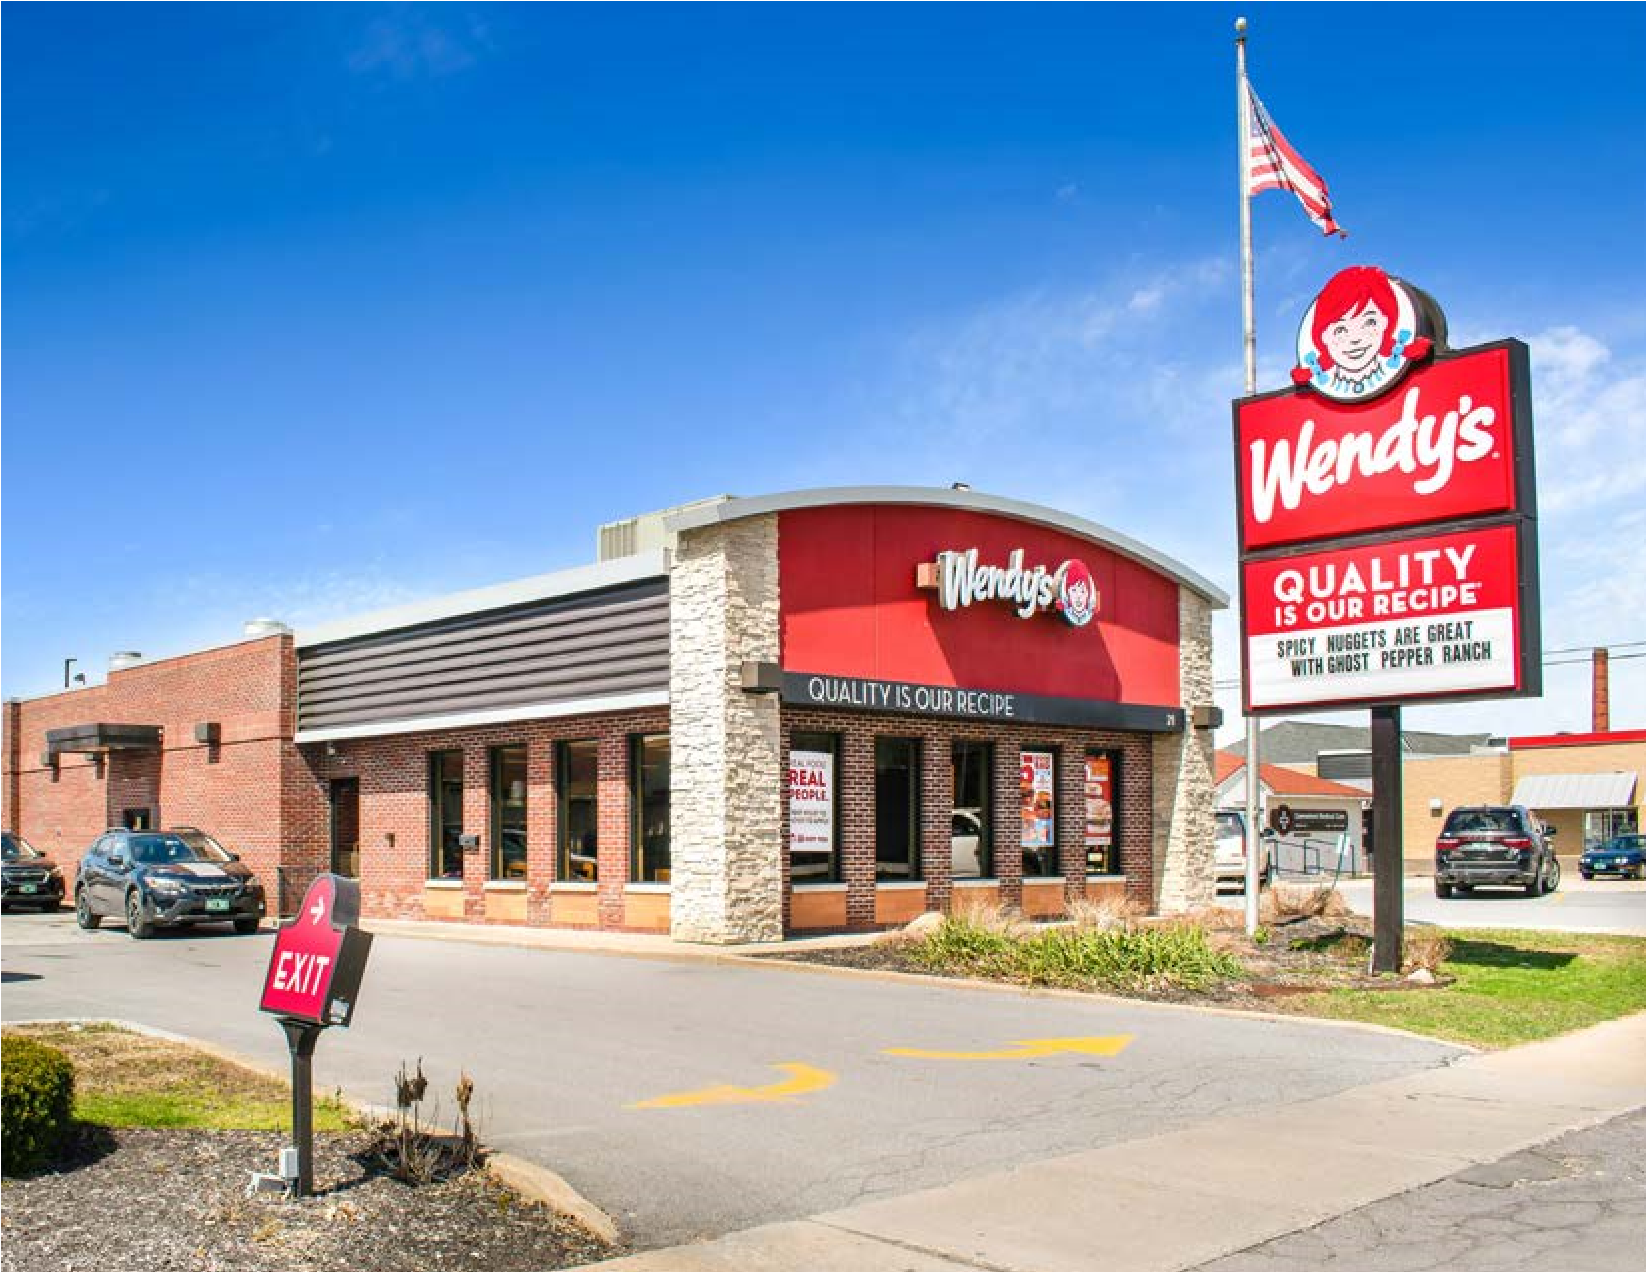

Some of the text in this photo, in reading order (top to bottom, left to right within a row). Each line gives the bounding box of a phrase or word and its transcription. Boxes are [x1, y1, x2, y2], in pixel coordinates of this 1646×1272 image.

[1250, 386, 1495, 524] Wendy's
[938, 548, 1053, 619] Wendy's
[1273, 544, 1477, 603] QUALITY
[1275, 583, 1478, 627] IS OUR RECIPE
[1277, 621, 1474, 658] SPICY NUGGETS ARE GREAT
[1291, 641, 1492, 677] WITH GHOST PEPPER RANCH
[809, 676, 1015, 717] QUALITY IS OUR RECIPE
[787, 769, 827, 787] REAL
[273, 950, 330, 996] EXIT
